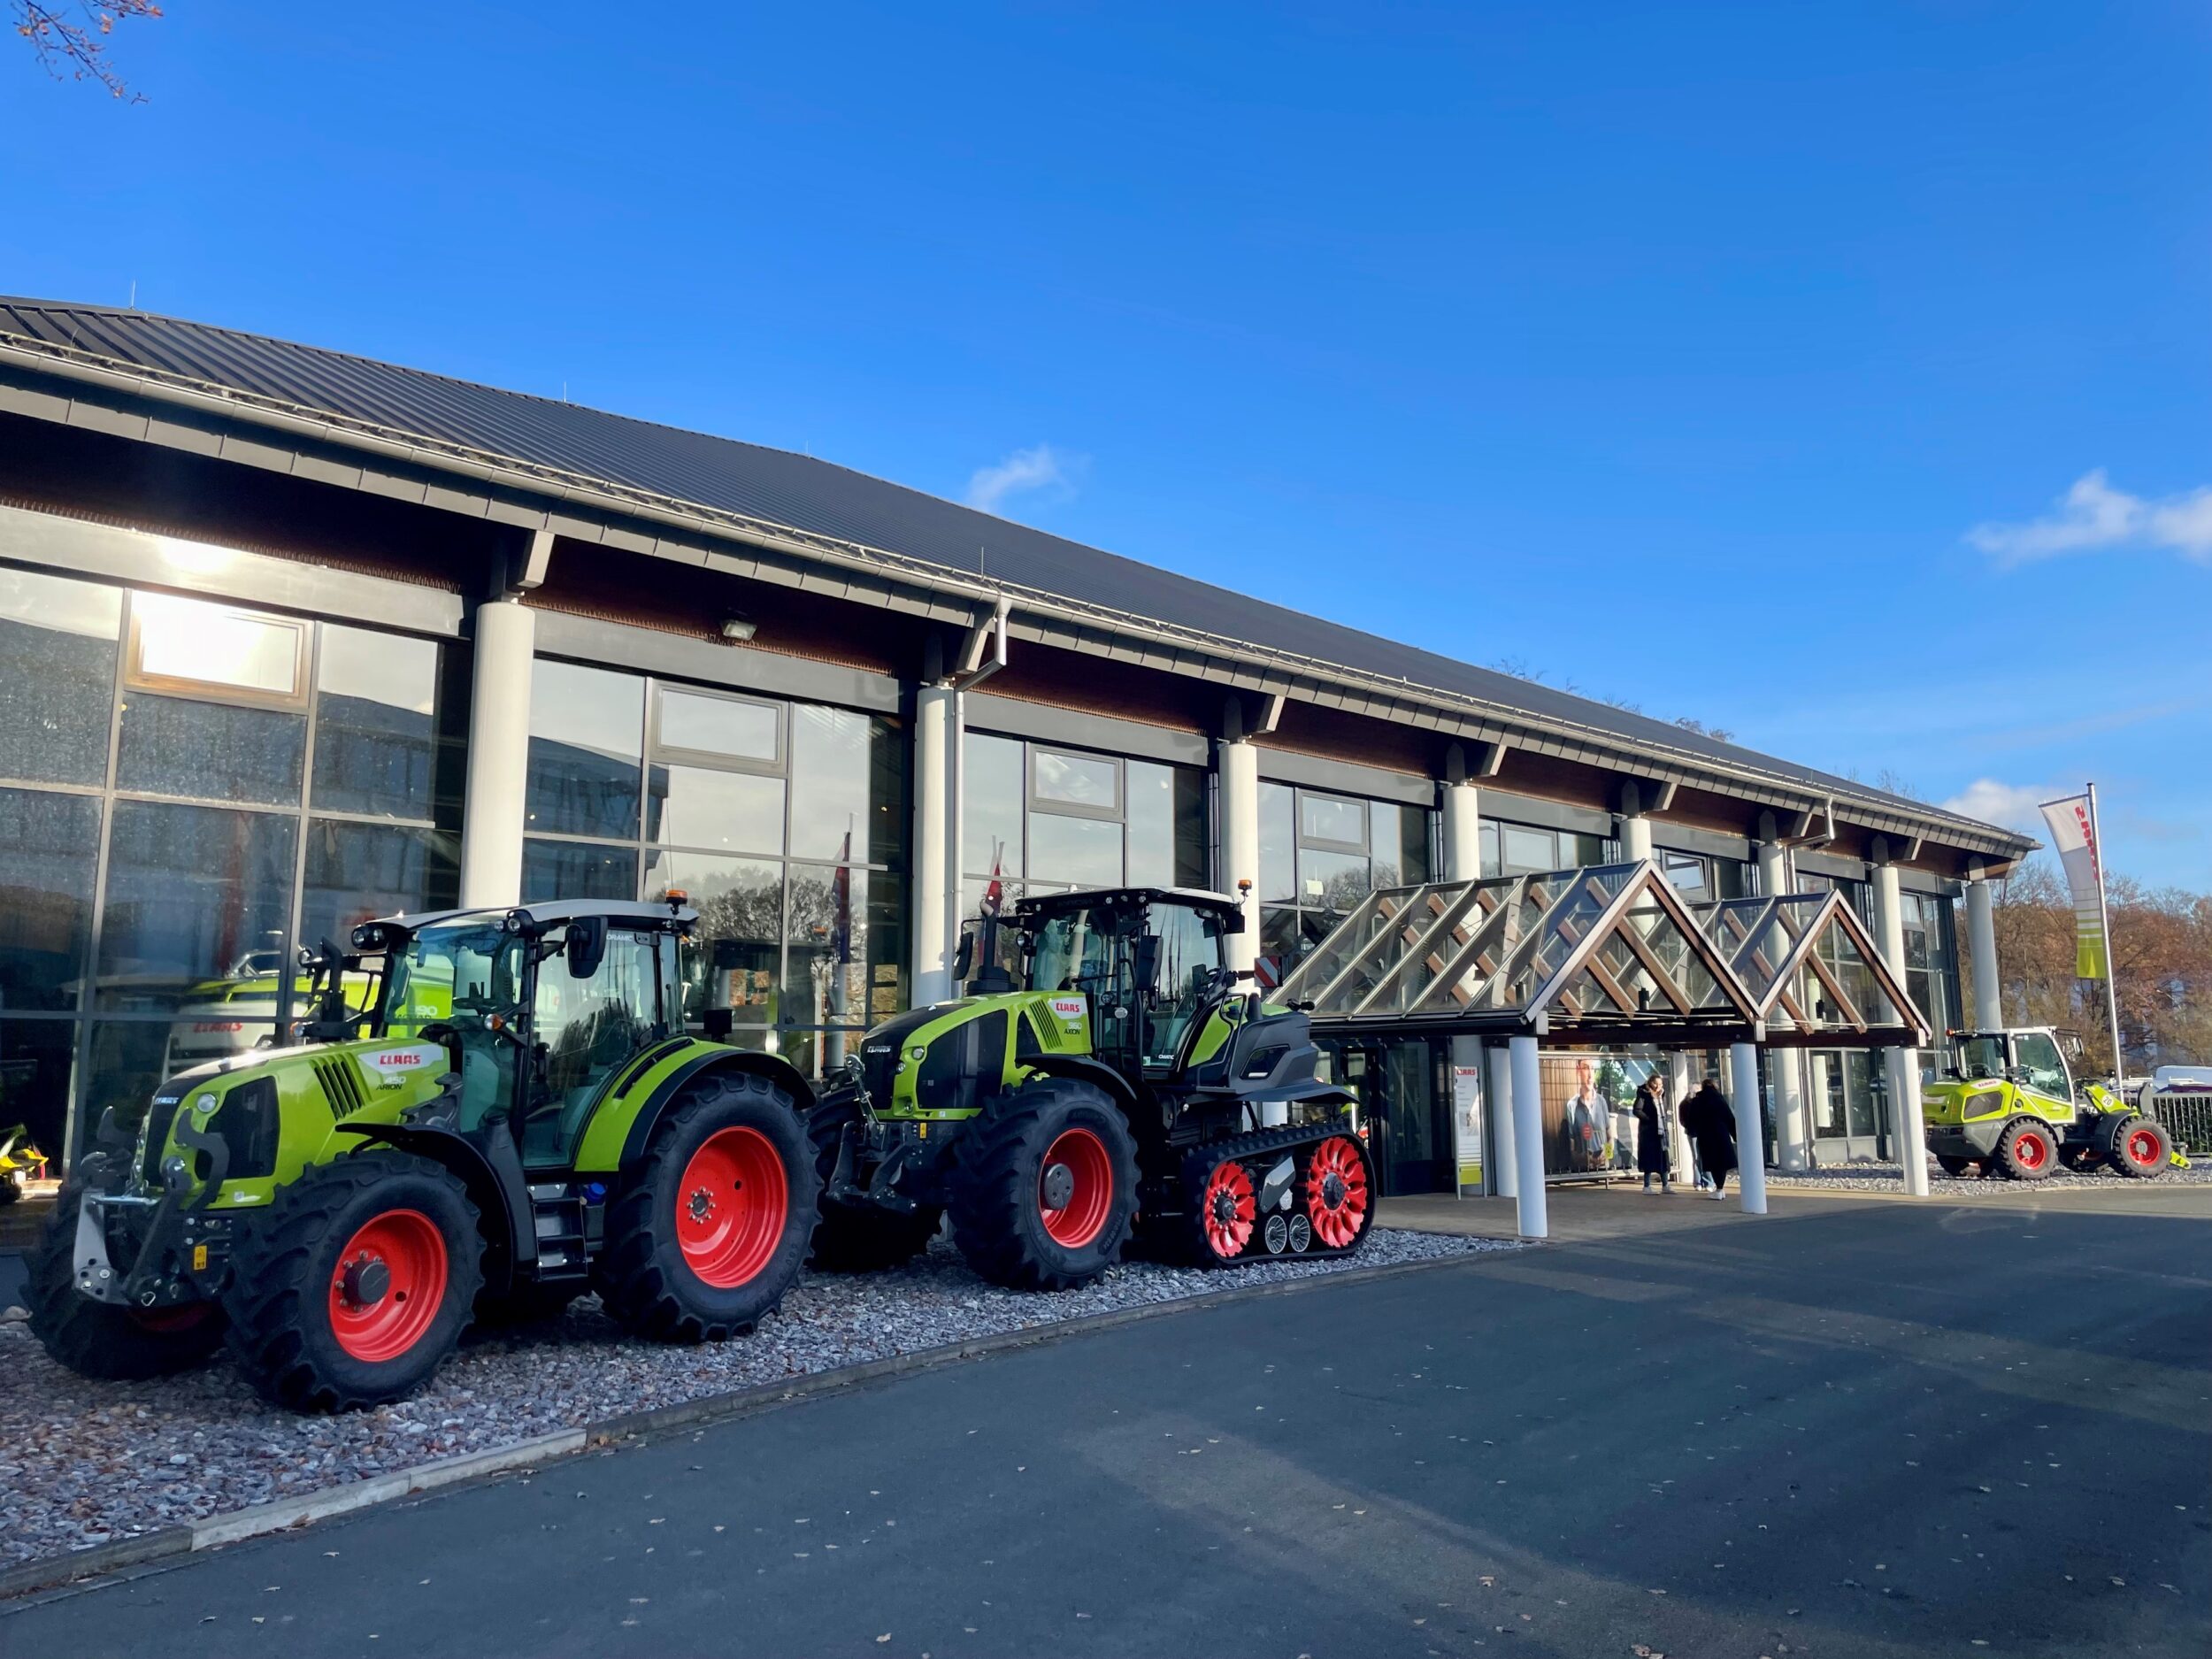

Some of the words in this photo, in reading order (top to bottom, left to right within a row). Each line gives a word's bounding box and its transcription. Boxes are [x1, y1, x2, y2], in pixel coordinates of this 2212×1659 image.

[1056, 1002, 1080, 1013] CLAAS
[867, 1045, 892, 1054] CLAAS
[380, 1055, 421, 1065] CLAAS
[2103, 1095, 2113, 1106] 20
